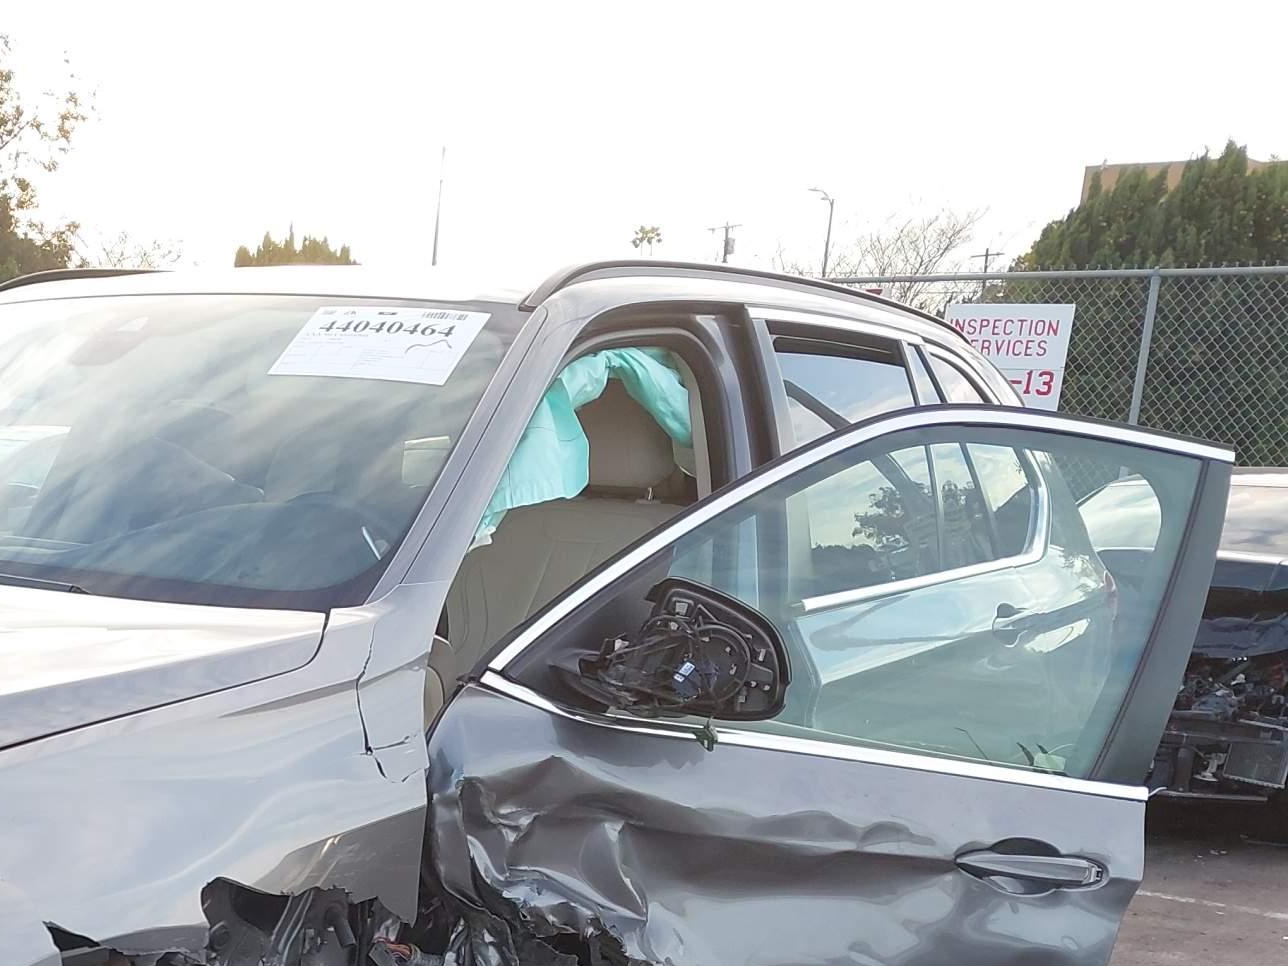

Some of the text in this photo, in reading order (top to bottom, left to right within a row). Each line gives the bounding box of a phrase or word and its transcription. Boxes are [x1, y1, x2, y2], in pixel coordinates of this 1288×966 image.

[319, 320, 456, 339] 44040464
[971, 339, 1047, 357] RVICES
[1008, 370, 1055, 396] -13
